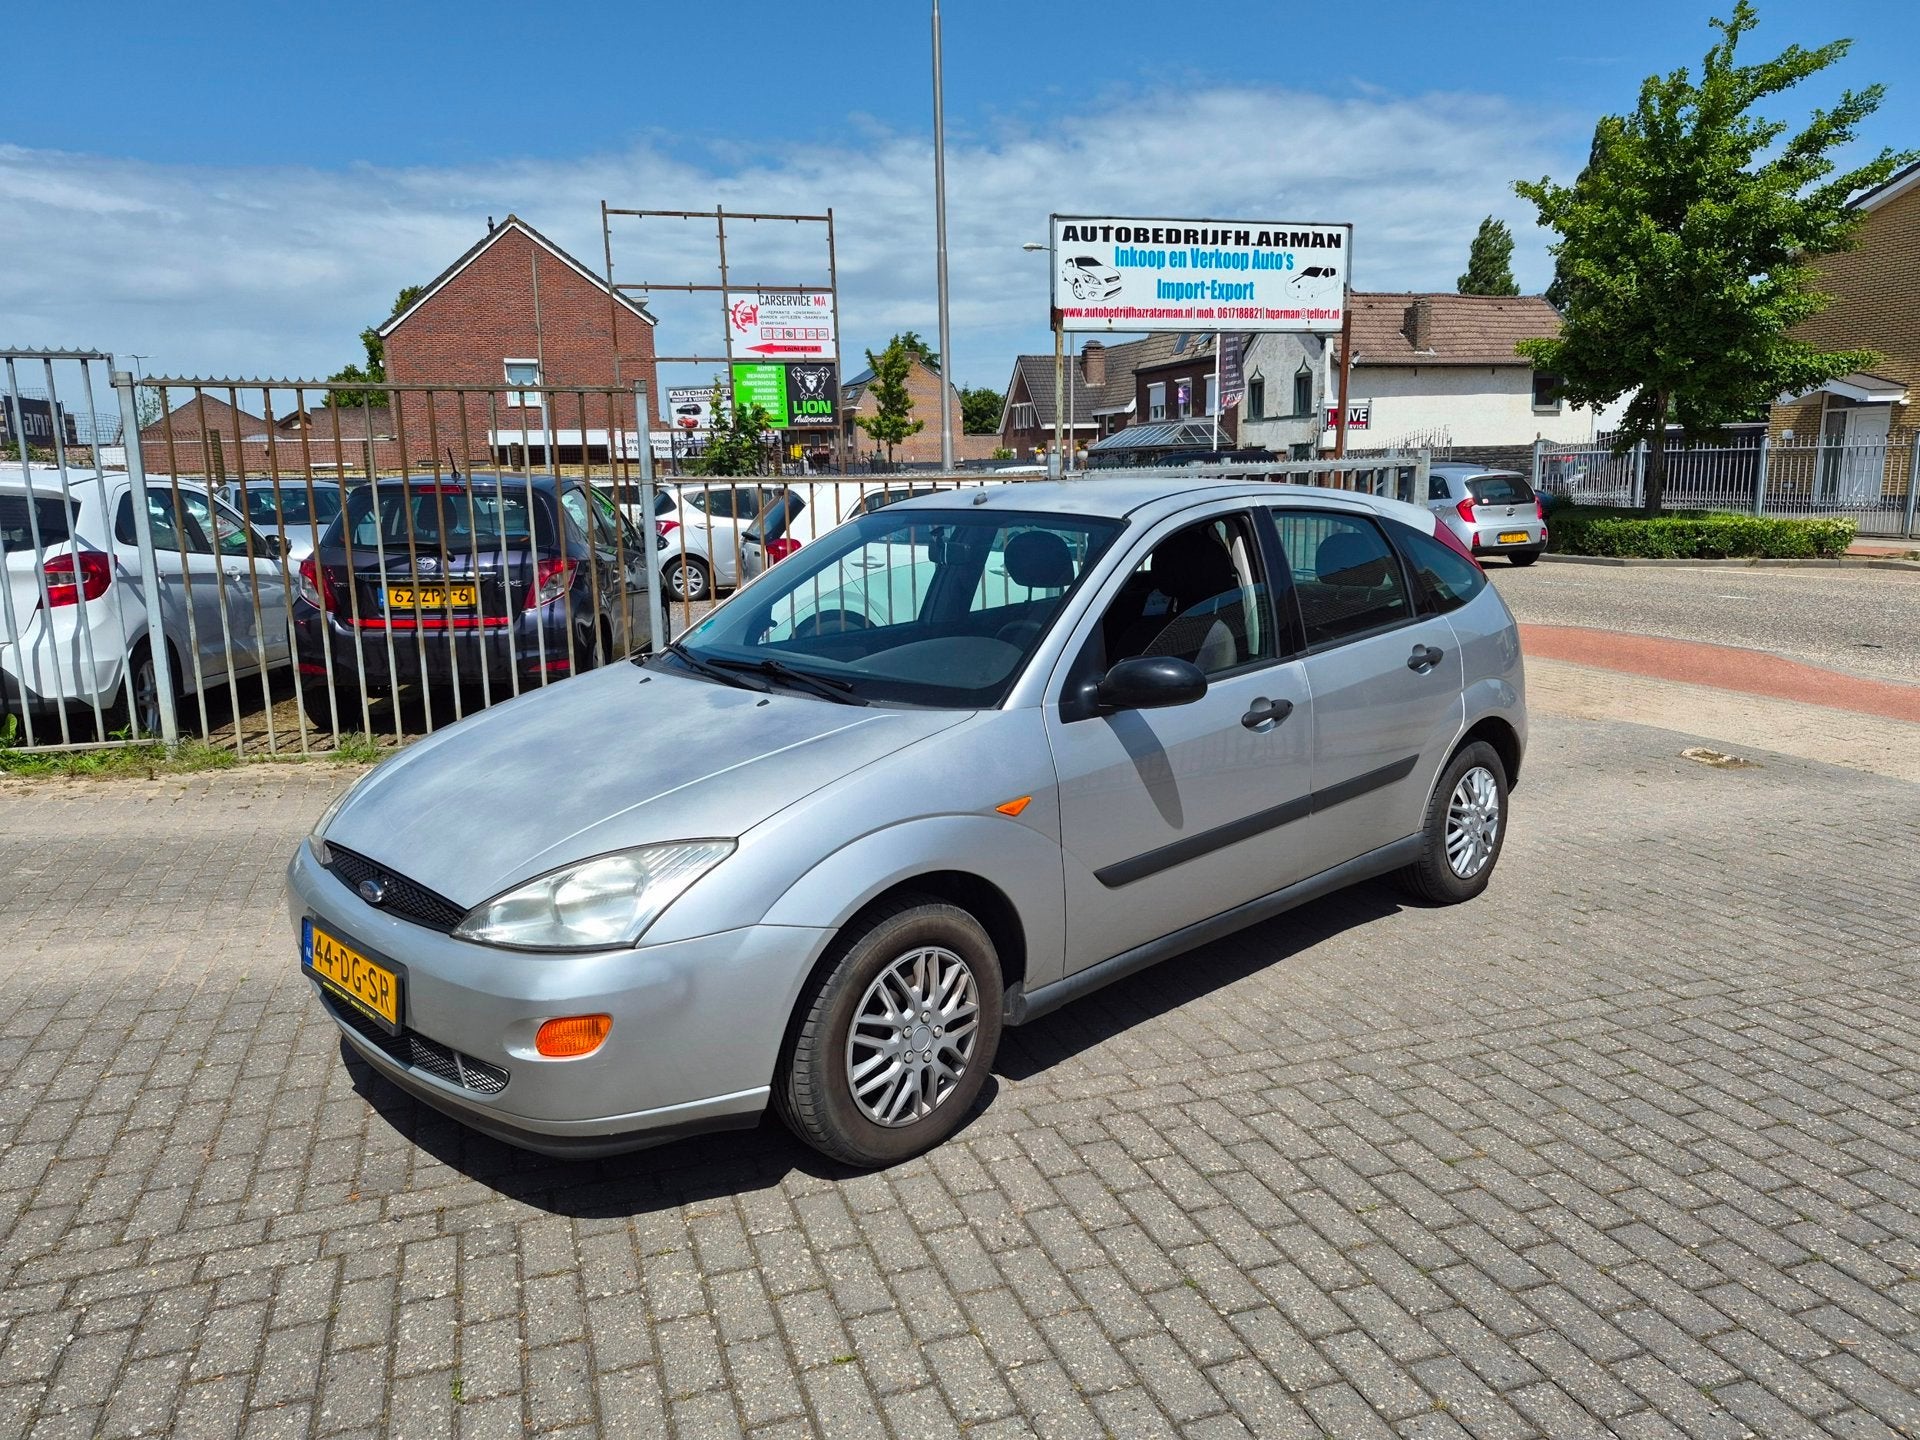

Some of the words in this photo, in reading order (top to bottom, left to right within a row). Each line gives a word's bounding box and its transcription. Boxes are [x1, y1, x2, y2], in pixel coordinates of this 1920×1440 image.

[1062, 225, 1342, 249] AUTOBEDRIJFH.ARMAN
[1115, 246, 1166, 270] Inkoop
[1169, 250, 1187, 268] en
[1190, 247, 1249, 272] Verkoop
[1252, 249, 1294, 271] Auto's
[1157, 278, 1255, 302] Import-Export
[759, 295, 811, 307] CARSERVICE
[813, 296, 826, 307] MA
[1217, 307, 1262, 319] 0617188821
[793, 400, 832, 414] LION
[793, 414, 833, 423] Autoservice
[315, 935, 390, 1013] 44-DG-SR
